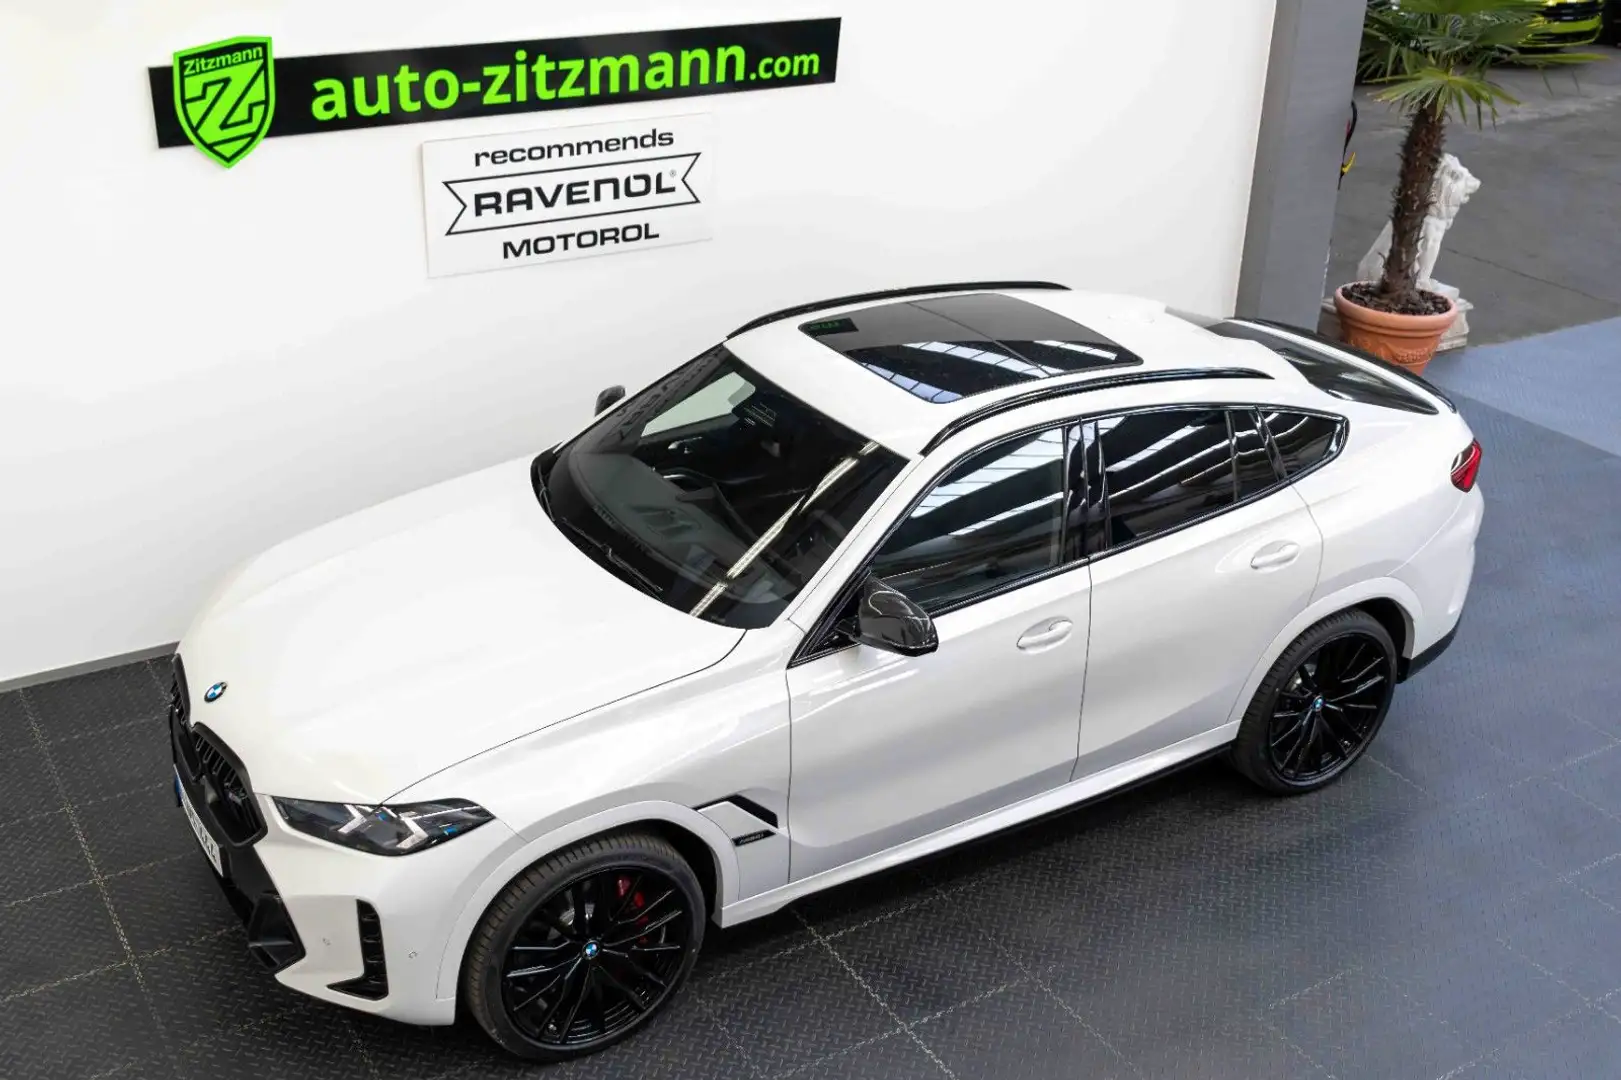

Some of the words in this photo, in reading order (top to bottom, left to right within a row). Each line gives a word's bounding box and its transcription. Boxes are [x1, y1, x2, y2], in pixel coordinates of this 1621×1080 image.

[183, 46, 263, 76] Zitzmann
[311, 45, 820, 122] auto-zitzmann.com
[475, 129, 674, 167] recommends
[503, 223, 660, 260] MOTOROL
